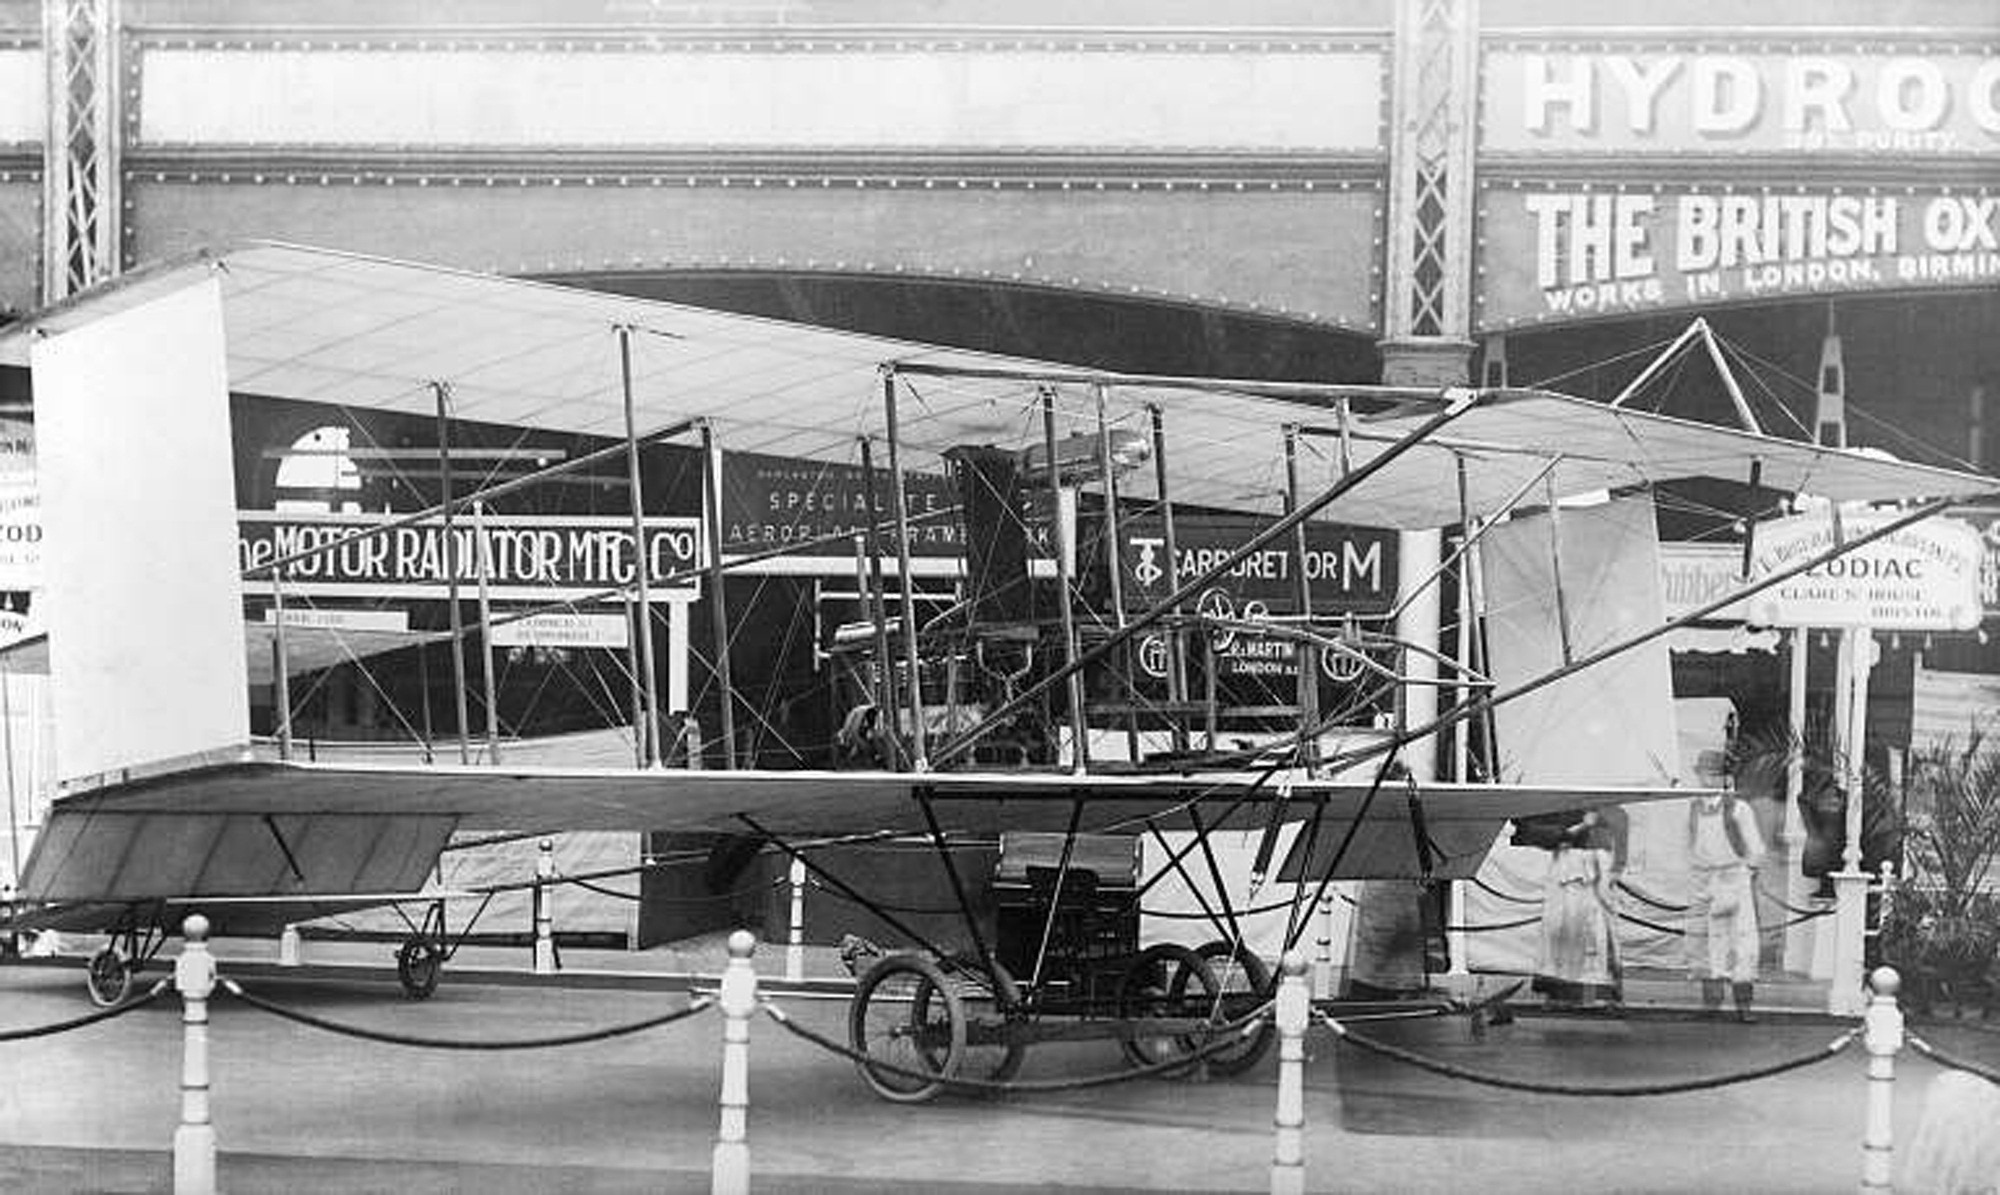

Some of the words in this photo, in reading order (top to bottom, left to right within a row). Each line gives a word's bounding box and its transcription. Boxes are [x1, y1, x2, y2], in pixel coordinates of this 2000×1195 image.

[1526, 194, 1656, 290] THE
[1677, 195, 1899, 272] BRITISH
[1546, 281, 1663, 312] WORKS
[274, 525, 389, 577] MOTOR
[395, 527, 561, 581] RADIATOR
